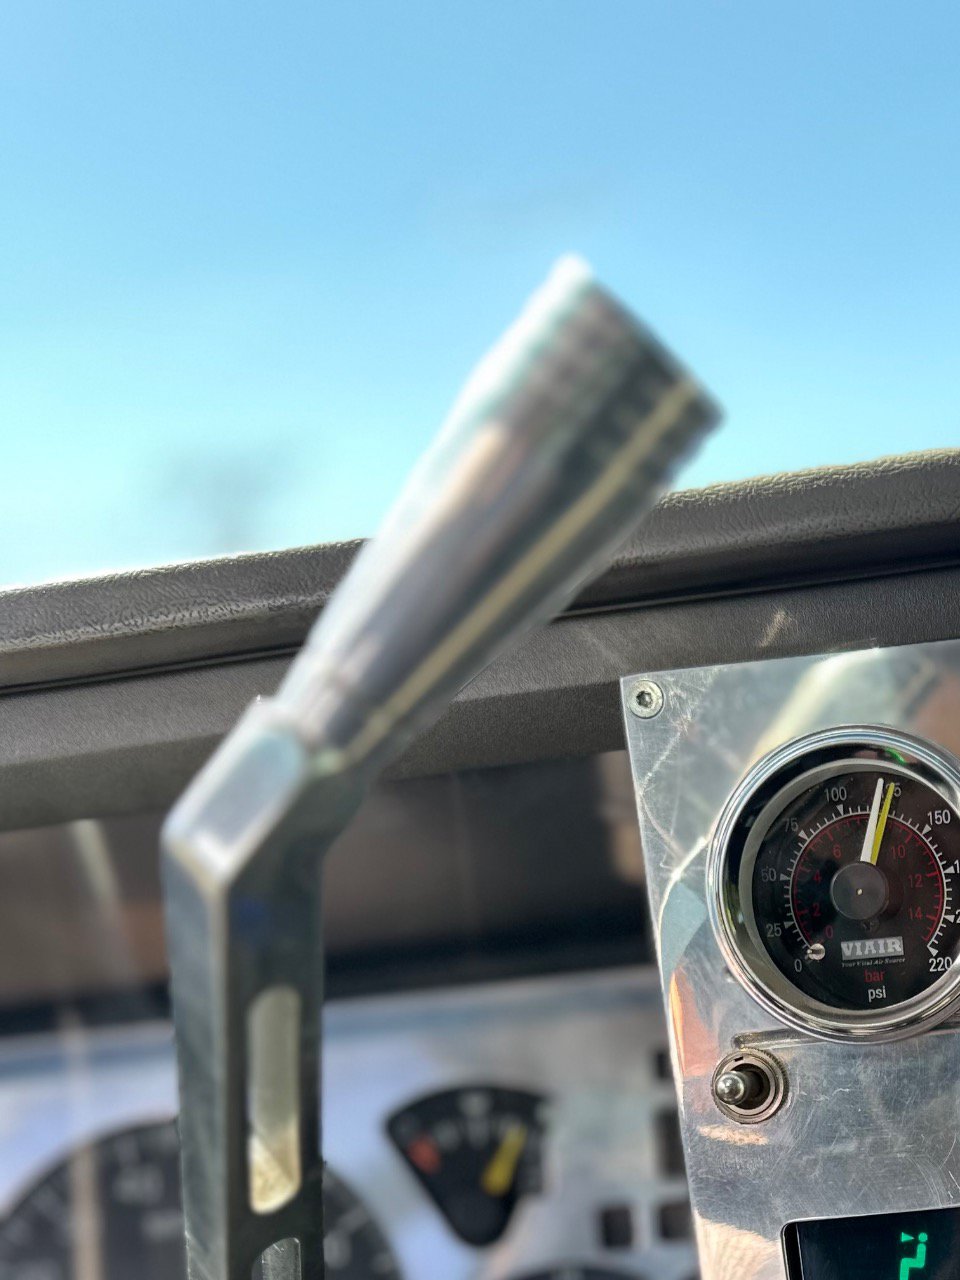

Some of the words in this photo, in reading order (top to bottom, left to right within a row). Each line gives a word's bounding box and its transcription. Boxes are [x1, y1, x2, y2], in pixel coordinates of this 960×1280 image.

[825, 786, 847, 802] 100
[782, 817, 799, 833] 75
[927, 809, 951, 826] 150
[891, 844, 907, 859] 10
[761, 868, 777, 882] 50
[908, 874, 923, 888] 12
[908, 906, 922, 920] 14
[766, 922, 782, 938] 25
[841, 938, 903, 958] VIAIR
[794, 958, 802, 973] 0
[929, 956, 953, 972] 220
[864, 967, 885, 983] bar
[868, 985, 887, 1003] psi
